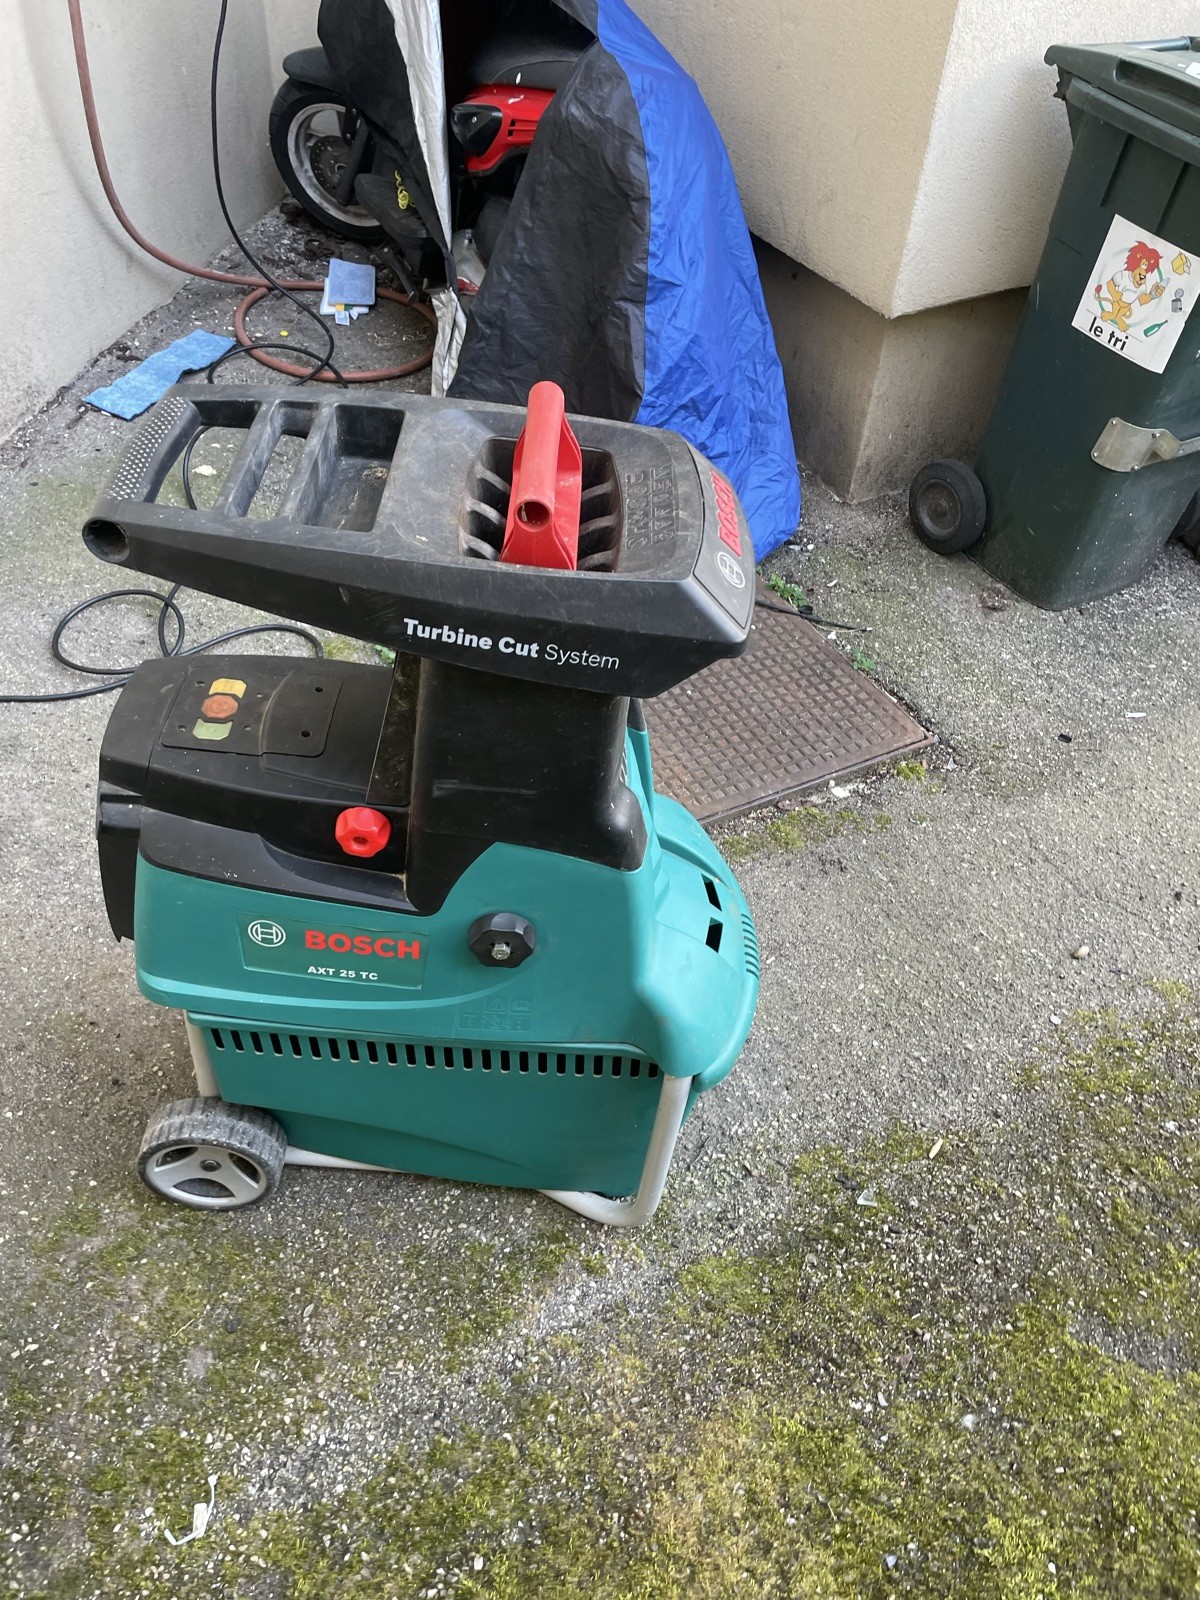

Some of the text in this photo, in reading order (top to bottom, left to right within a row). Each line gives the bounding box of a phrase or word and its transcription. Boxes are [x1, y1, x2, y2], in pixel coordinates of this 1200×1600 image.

[1088, 316, 1129, 351] le tri
[709, 469, 743, 558] BOSCH
[403, 617, 620, 670] Turbine Cut System
[304, 930, 421, 960] BOSCH
[307, 965, 378, 981] AXT 25 TC
